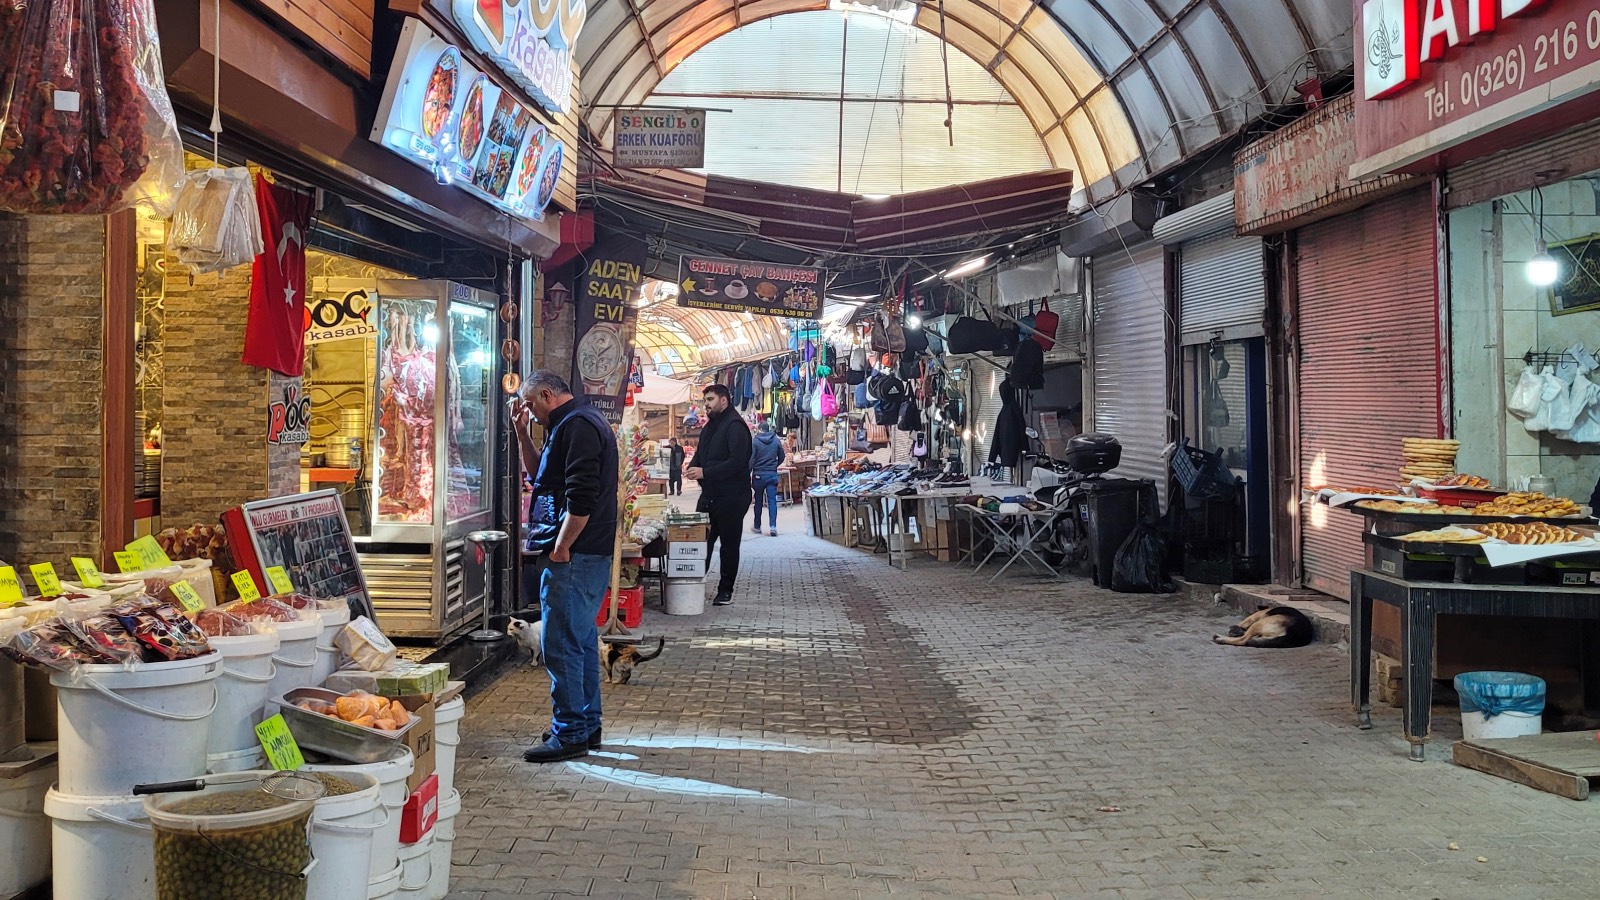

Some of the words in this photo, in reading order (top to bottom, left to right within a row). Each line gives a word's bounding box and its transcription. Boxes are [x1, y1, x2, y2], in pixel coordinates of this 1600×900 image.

[1424, 80, 1455, 121] Tel.
[1460, 44, 1526, 108] 0(326)
[1533, 21, 1578, 73] 216
[621, 114, 687, 130] ŞENGÜL
[617, 133, 647, 147] ERKEK
[649, 130, 701, 147] KUAFÖRÜ
[588, 258, 641, 284] ADEN
[689, 259, 738, 276] CENNET
[740, 264, 765, 280] ÇAY
[766, 268, 819, 284] BAHÇESİ
[587, 281, 634, 302] SAAT
[594, 300, 625, 322] EVİ
[723, 303, 744, 311] SERVİS
[309, 324, 378, 341] kasabı
[594, 399, 615, 410] TÜRLÜ
[301, 506, 309, 517] TV
